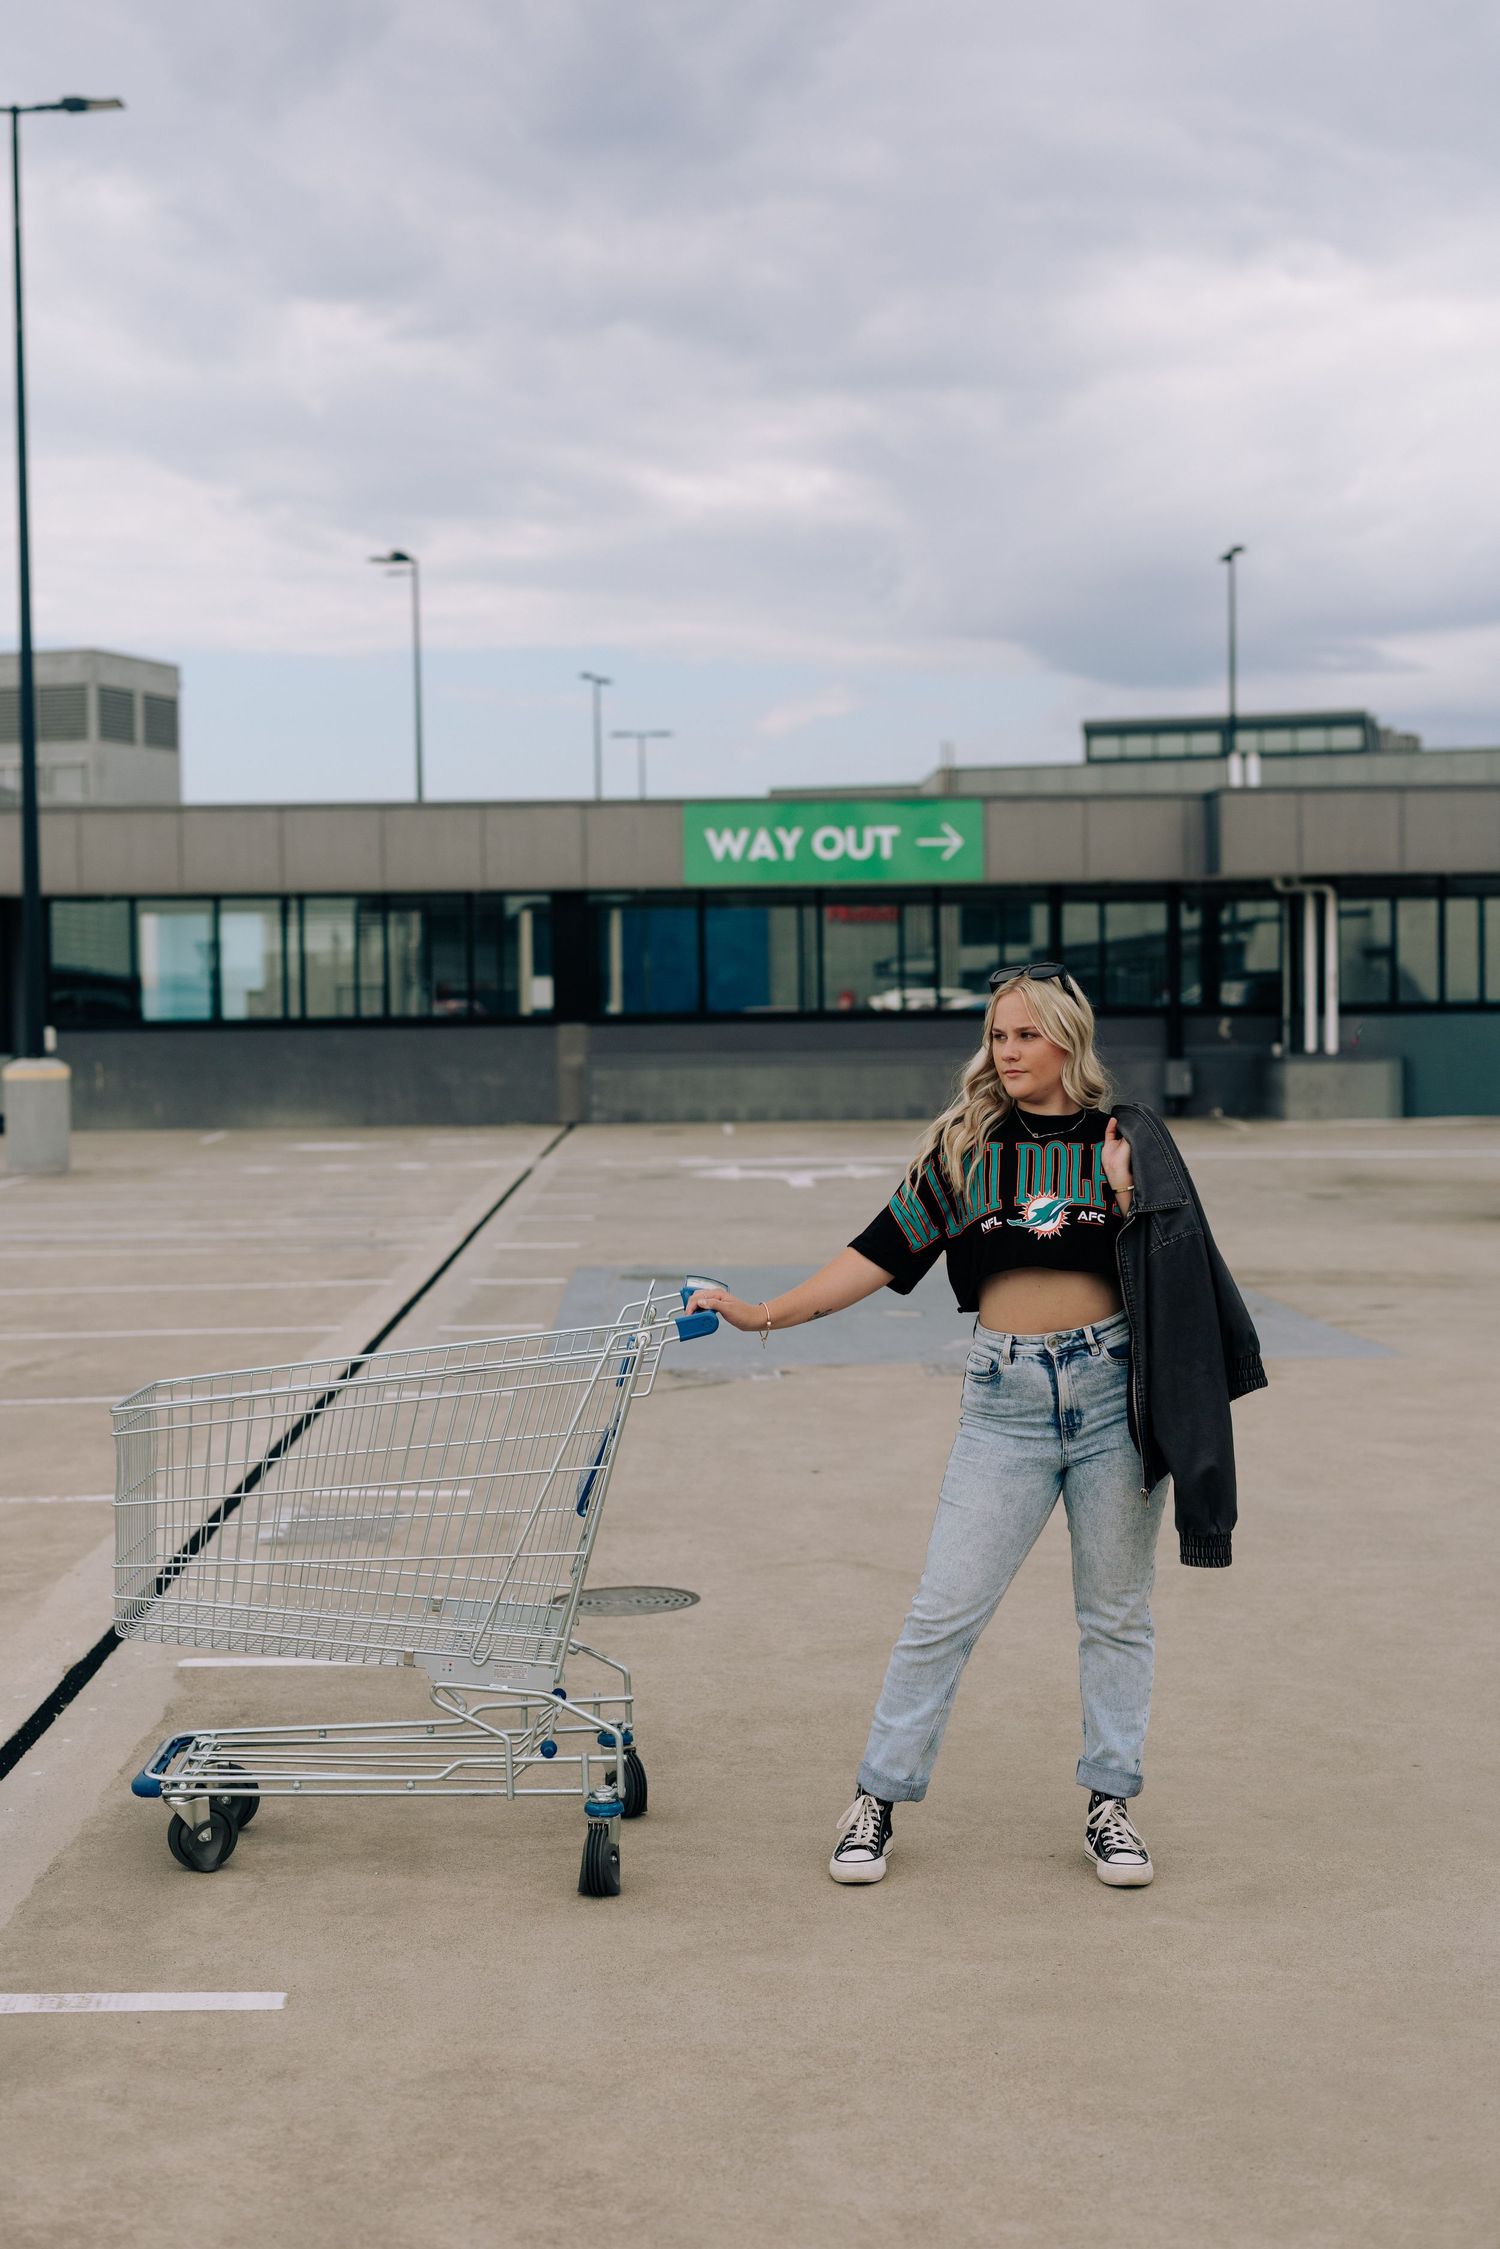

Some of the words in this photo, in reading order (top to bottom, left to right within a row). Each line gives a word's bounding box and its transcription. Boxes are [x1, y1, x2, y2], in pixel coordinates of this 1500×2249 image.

[705, 827, 803, 861] WAY
[812, 826, 899, 860] OUT
[888, 1142, 1003, 1252] MIMI
[981, 1216, 1002, 1232] NFL
[1077, 1210, 1106, 1223] AFC
